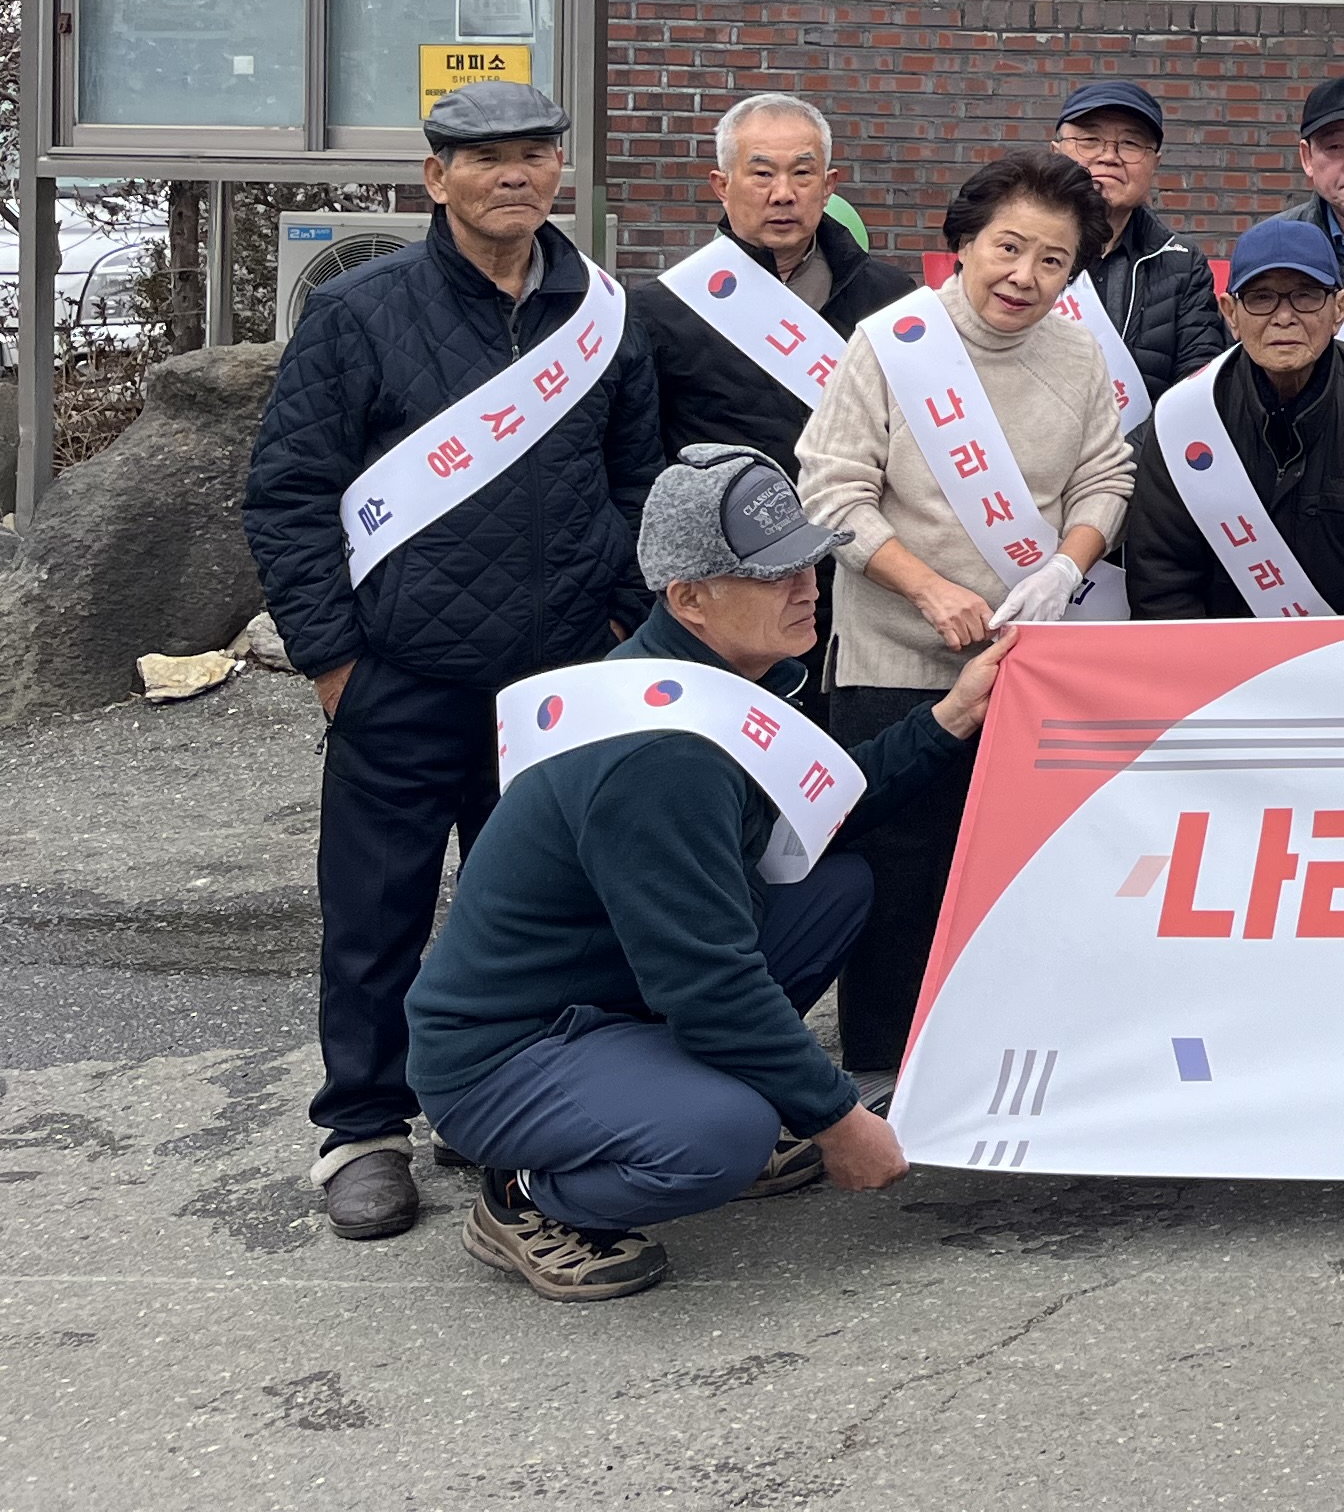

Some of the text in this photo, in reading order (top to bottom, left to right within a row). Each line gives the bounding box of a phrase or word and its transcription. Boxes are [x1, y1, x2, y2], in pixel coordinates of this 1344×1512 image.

[446, 54, 506, 70] 대피소
[426, 320, 604, 478] 나라사랑
[743, 488, 774, 516] CLASSIC
[925, 388, 1043, 567] 나라사랑
